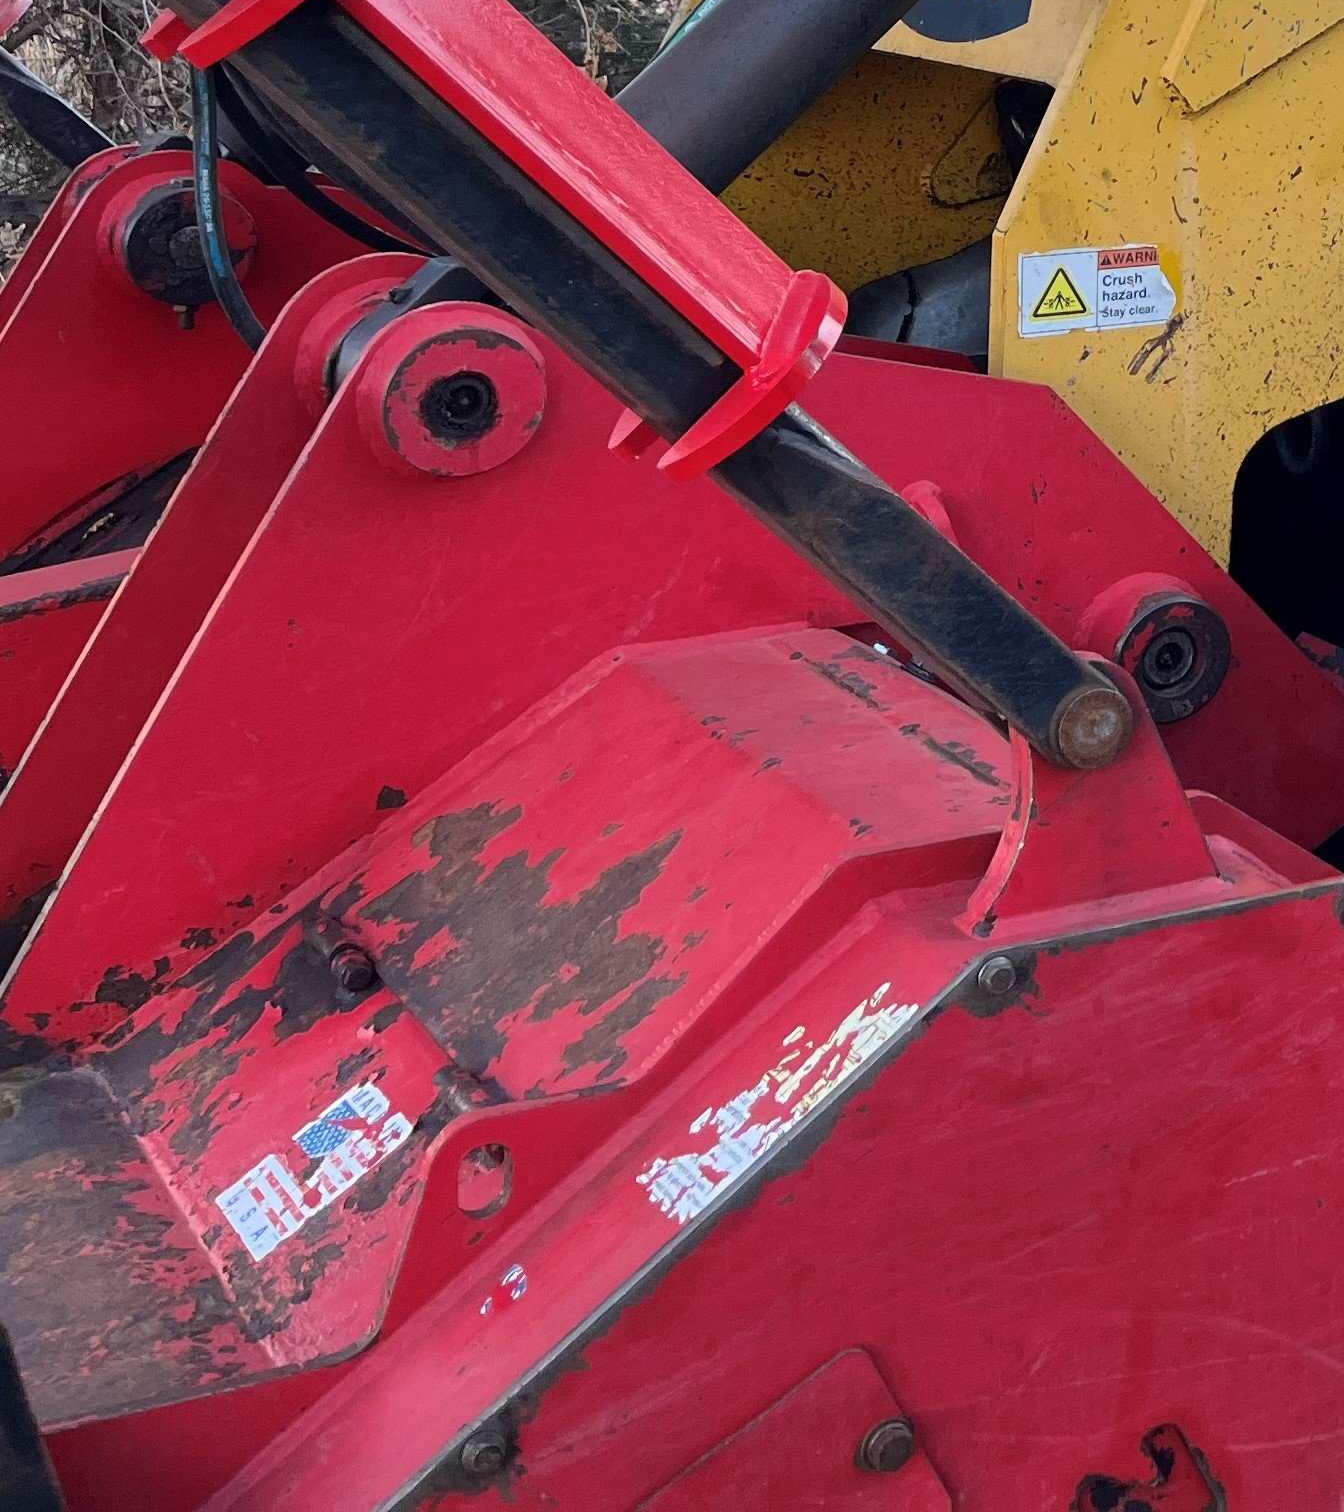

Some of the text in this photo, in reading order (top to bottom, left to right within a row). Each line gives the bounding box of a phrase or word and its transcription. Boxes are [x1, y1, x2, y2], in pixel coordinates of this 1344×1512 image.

[1113, 250, 1158, 265] WARNI
[1102, 272, 1143, 287] Crush
[1101, 306, 1126, 319] Stay
[351, 1088, 386, 1122] MAD
